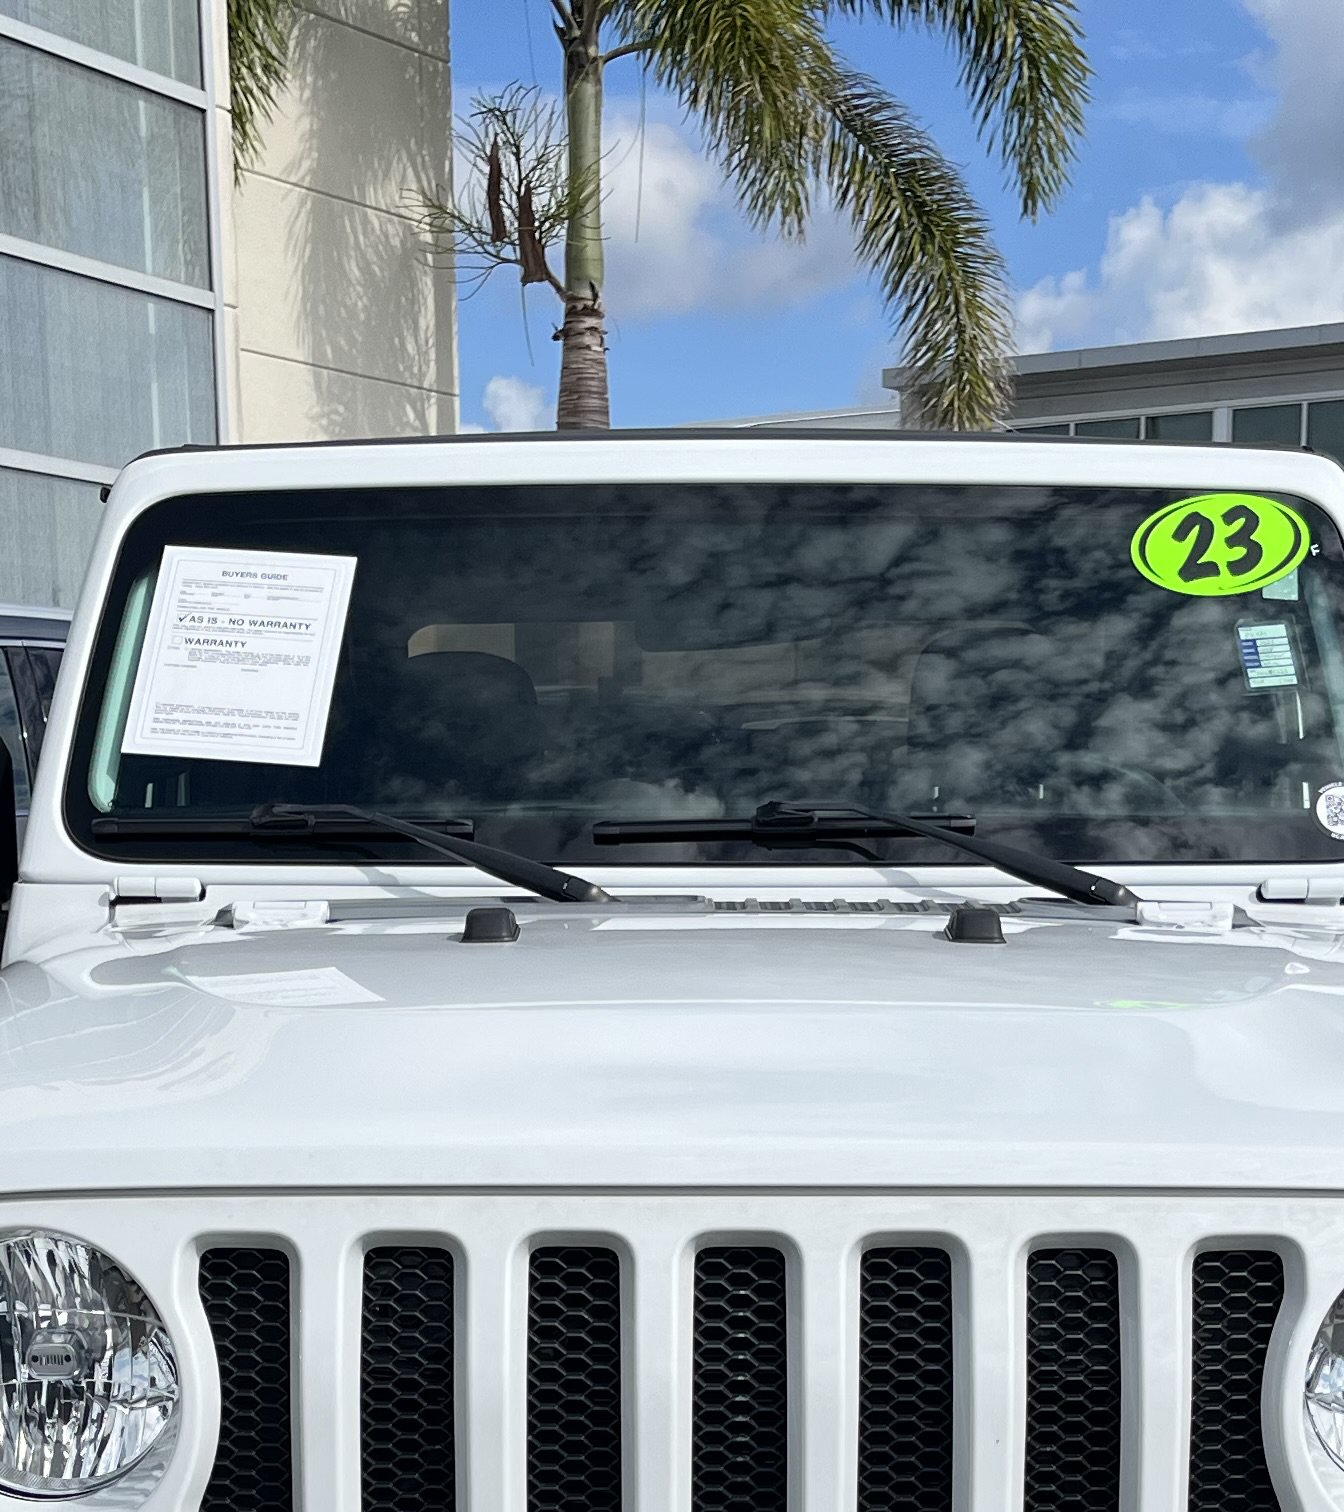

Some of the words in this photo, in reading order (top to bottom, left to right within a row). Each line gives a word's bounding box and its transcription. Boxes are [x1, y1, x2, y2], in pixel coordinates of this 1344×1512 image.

[1171, 504, 1264, 583] 23
[221, 570, 258, 580] BUYERS
[260, 572, 289, 582] GUIDE
[189, 615, 204, 625] AS
[207, 616, 218, 625] IS
[228, 618, 245, 627] NO
[248, 619, 312, 632] WARRANTY
[184, 637, 248, 649] WARRANTY
